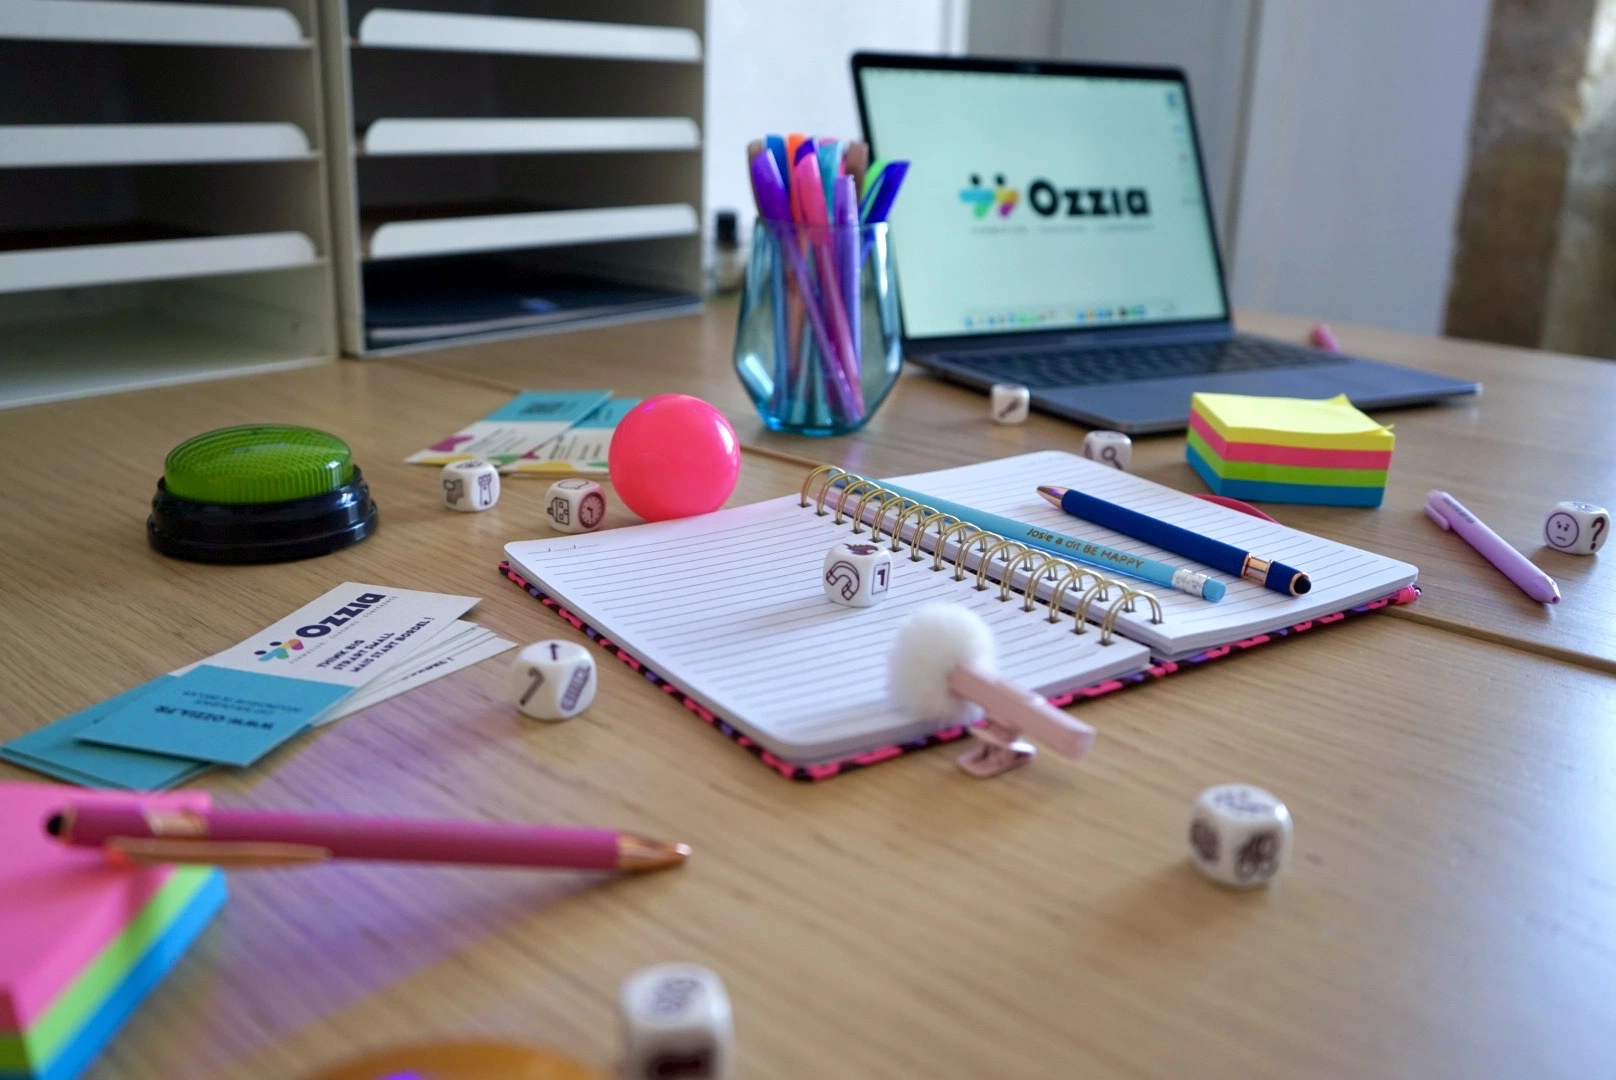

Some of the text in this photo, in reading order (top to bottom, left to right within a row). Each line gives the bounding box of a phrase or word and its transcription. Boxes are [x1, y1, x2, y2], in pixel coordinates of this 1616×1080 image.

[1028, 177, 1150, 217] Ozzia
[1026, 528, 1054, 542] Josie
[1066, 540, 1081, 551] dit
[1083, 545, 1099, 556] BE
[1101, 549, 1144, 569] HAPPY
[877, 569, 886, 586] 1
[295, 593, 387, 638] Ozzia
[316, 639, 366, 668] THINK BIG
[350, 658, 375, 672] MAIS
[371, 641, 398, 659] START
[395, 620, 431, 642] BORDEL
[364, 632, 395, 650] SMALL
